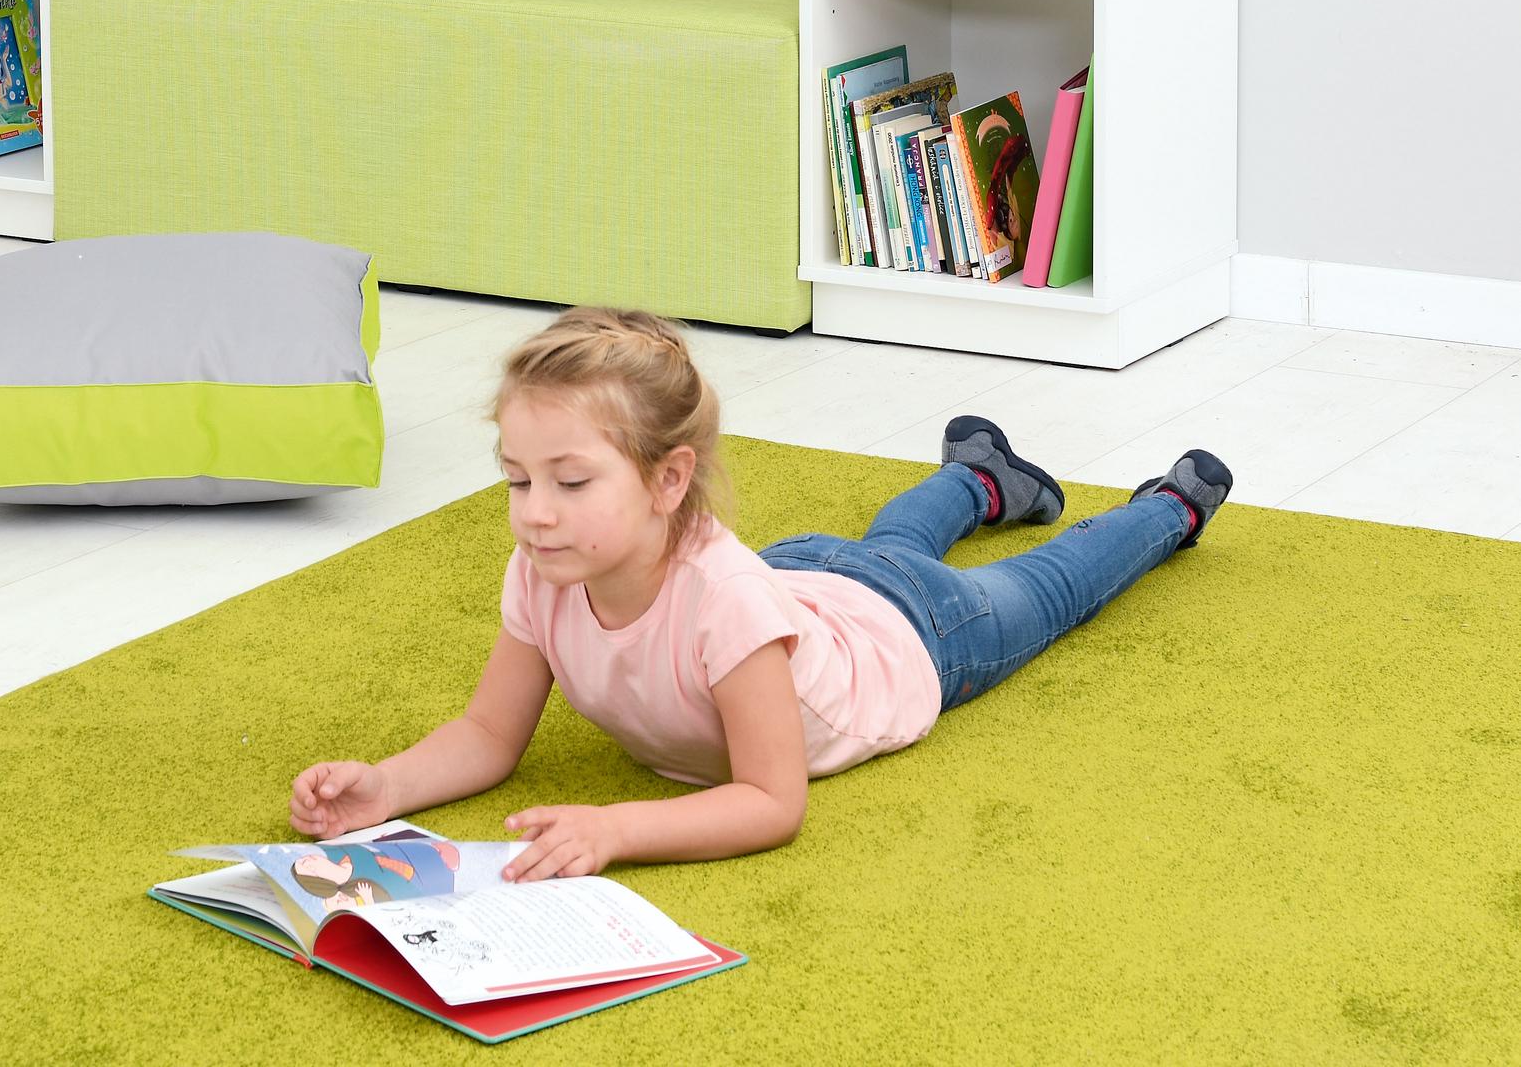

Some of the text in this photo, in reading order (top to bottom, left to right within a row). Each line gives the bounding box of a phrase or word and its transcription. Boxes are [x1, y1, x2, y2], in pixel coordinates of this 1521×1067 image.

[913, 143, 924, 188] FRANCJA
[911, 176, 922, 217] HONG KONG
